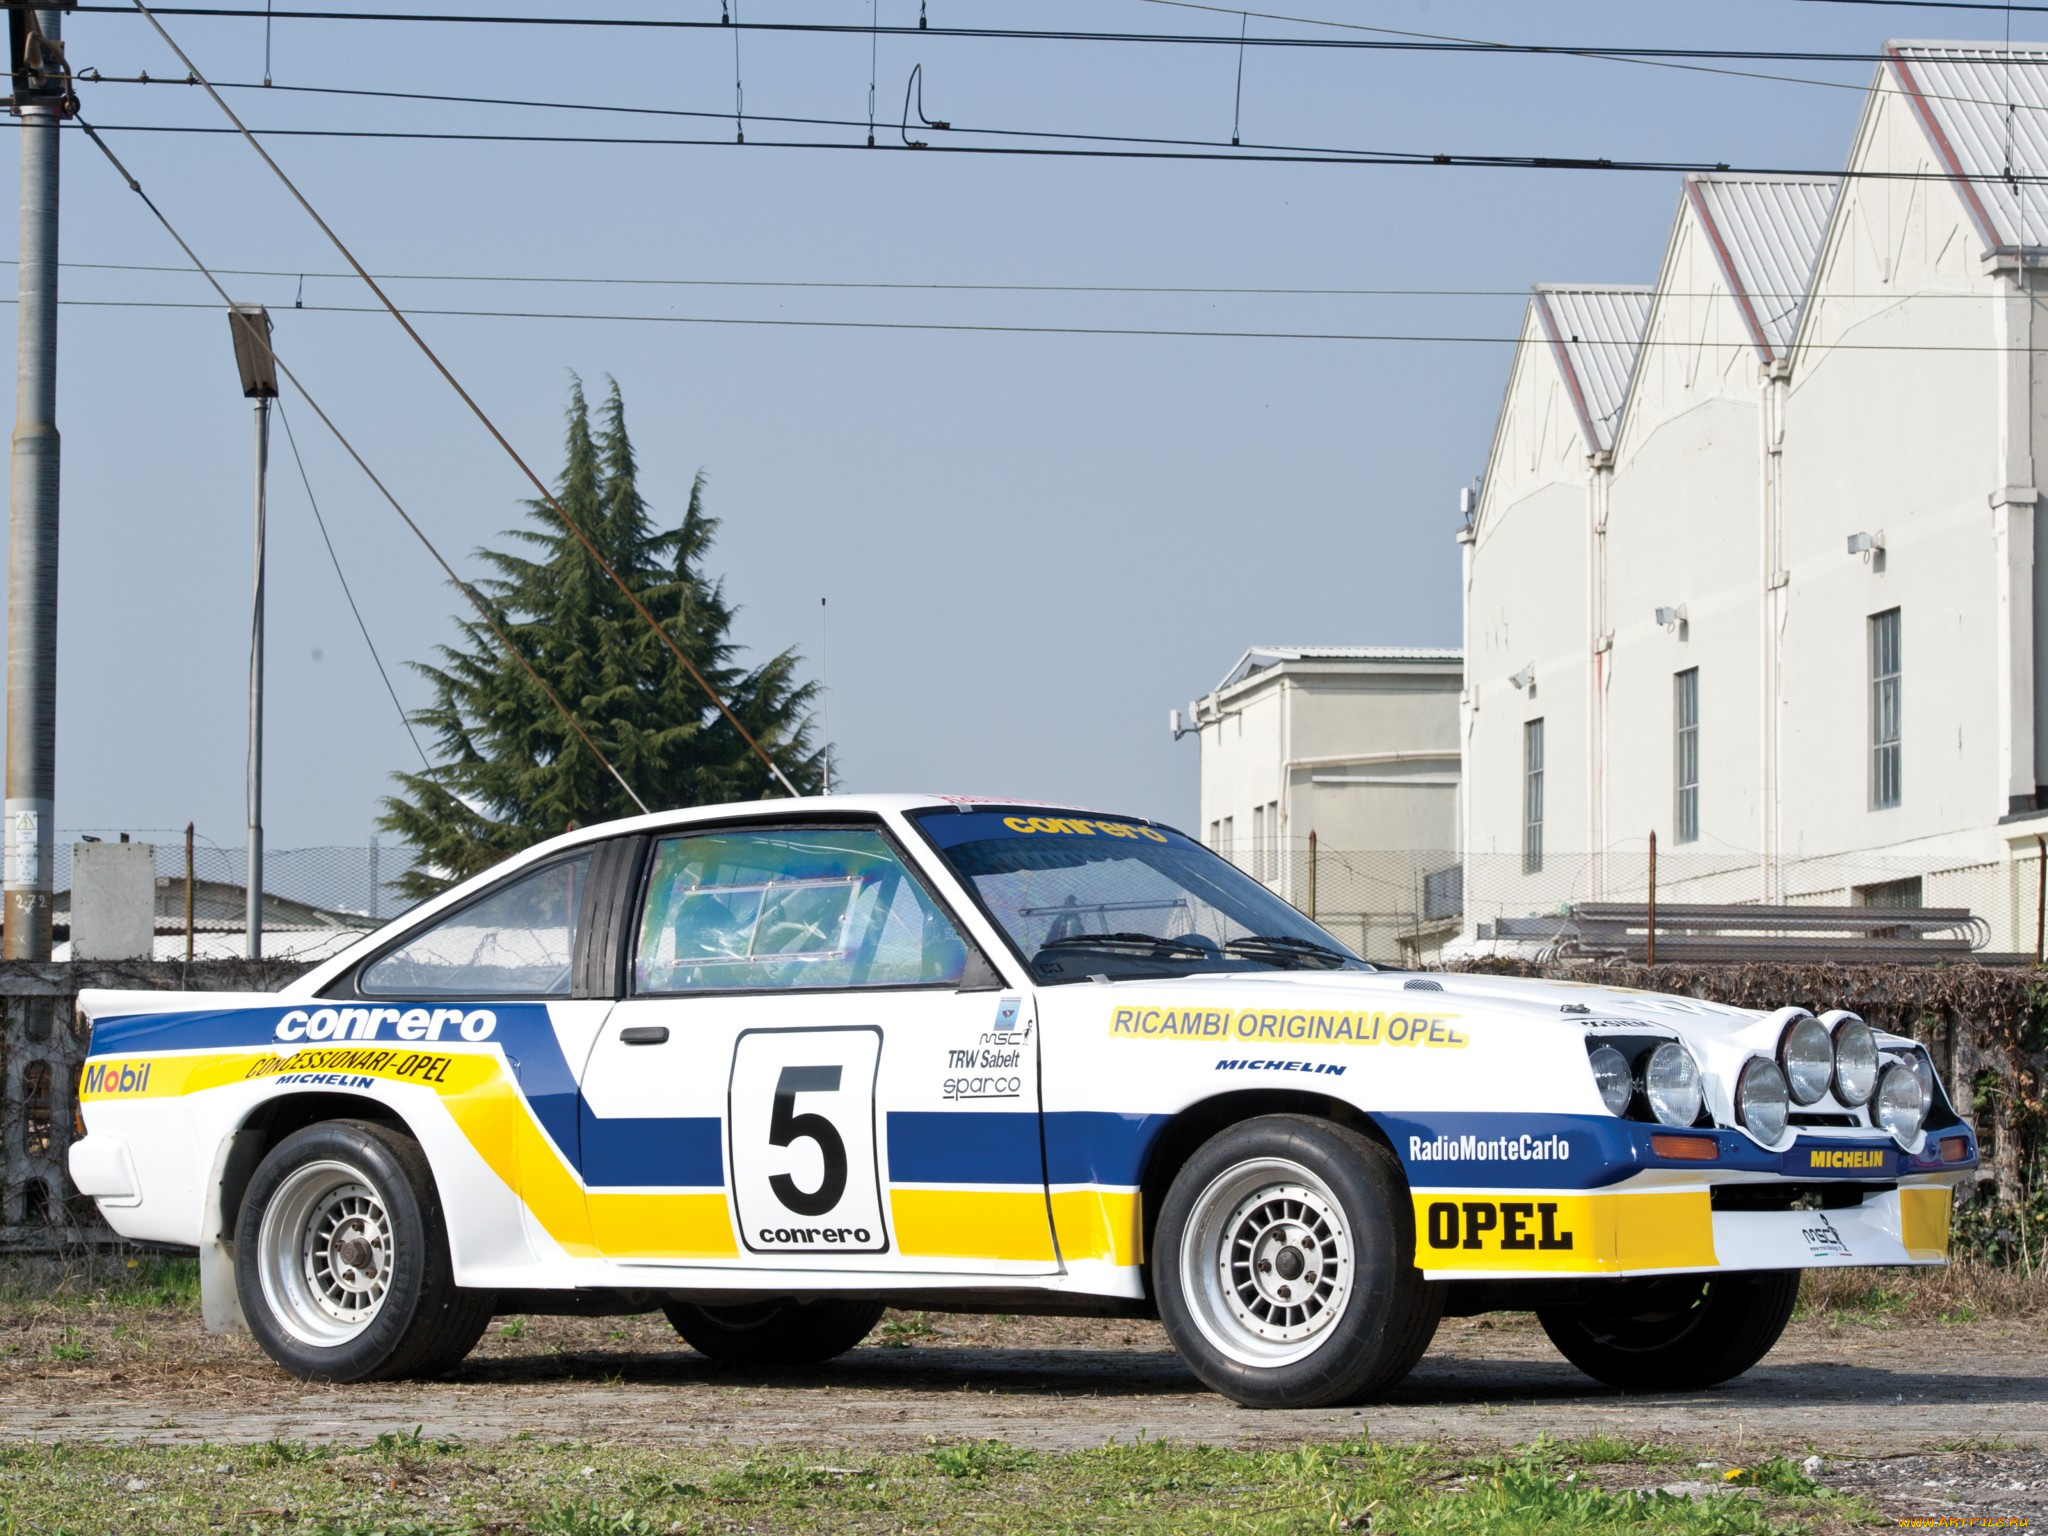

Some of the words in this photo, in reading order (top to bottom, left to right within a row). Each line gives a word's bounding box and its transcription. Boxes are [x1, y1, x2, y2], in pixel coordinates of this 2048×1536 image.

[1003, 816, 1168, 843] conrero
[275, 1008, 497, 1042] conrero
[1114, 1009, 1231, 1036] RICAMBI
[1237, 1013, 1380, 1040] ORIGINALI
[1387, 1016, 1464, 1043] OPEL
[245, 1050, 452, 1084] CONCESSIONARI-OPEL
[948, 1050, 978, 1069] TRW
[980, 1049, 1020, 1068] Sabelt
[1215, 1059, 1347, 1076] MICHELIN
[83, 1062, 151, 1094] Mobil
[276, 1074, 374, 1089] MICHELIN
[943, 1076, 1021, 1101] sparco
[768, 1065, 848, 1217] 5
[1409, 1134, 1570, 1161] RadioMonteCarlo
[1810, 1150, 1884, 1169] MICHELIN
[759, 1227, 871, 1244] conrero
[1428, 1202, 1573, 1251] OPEL
